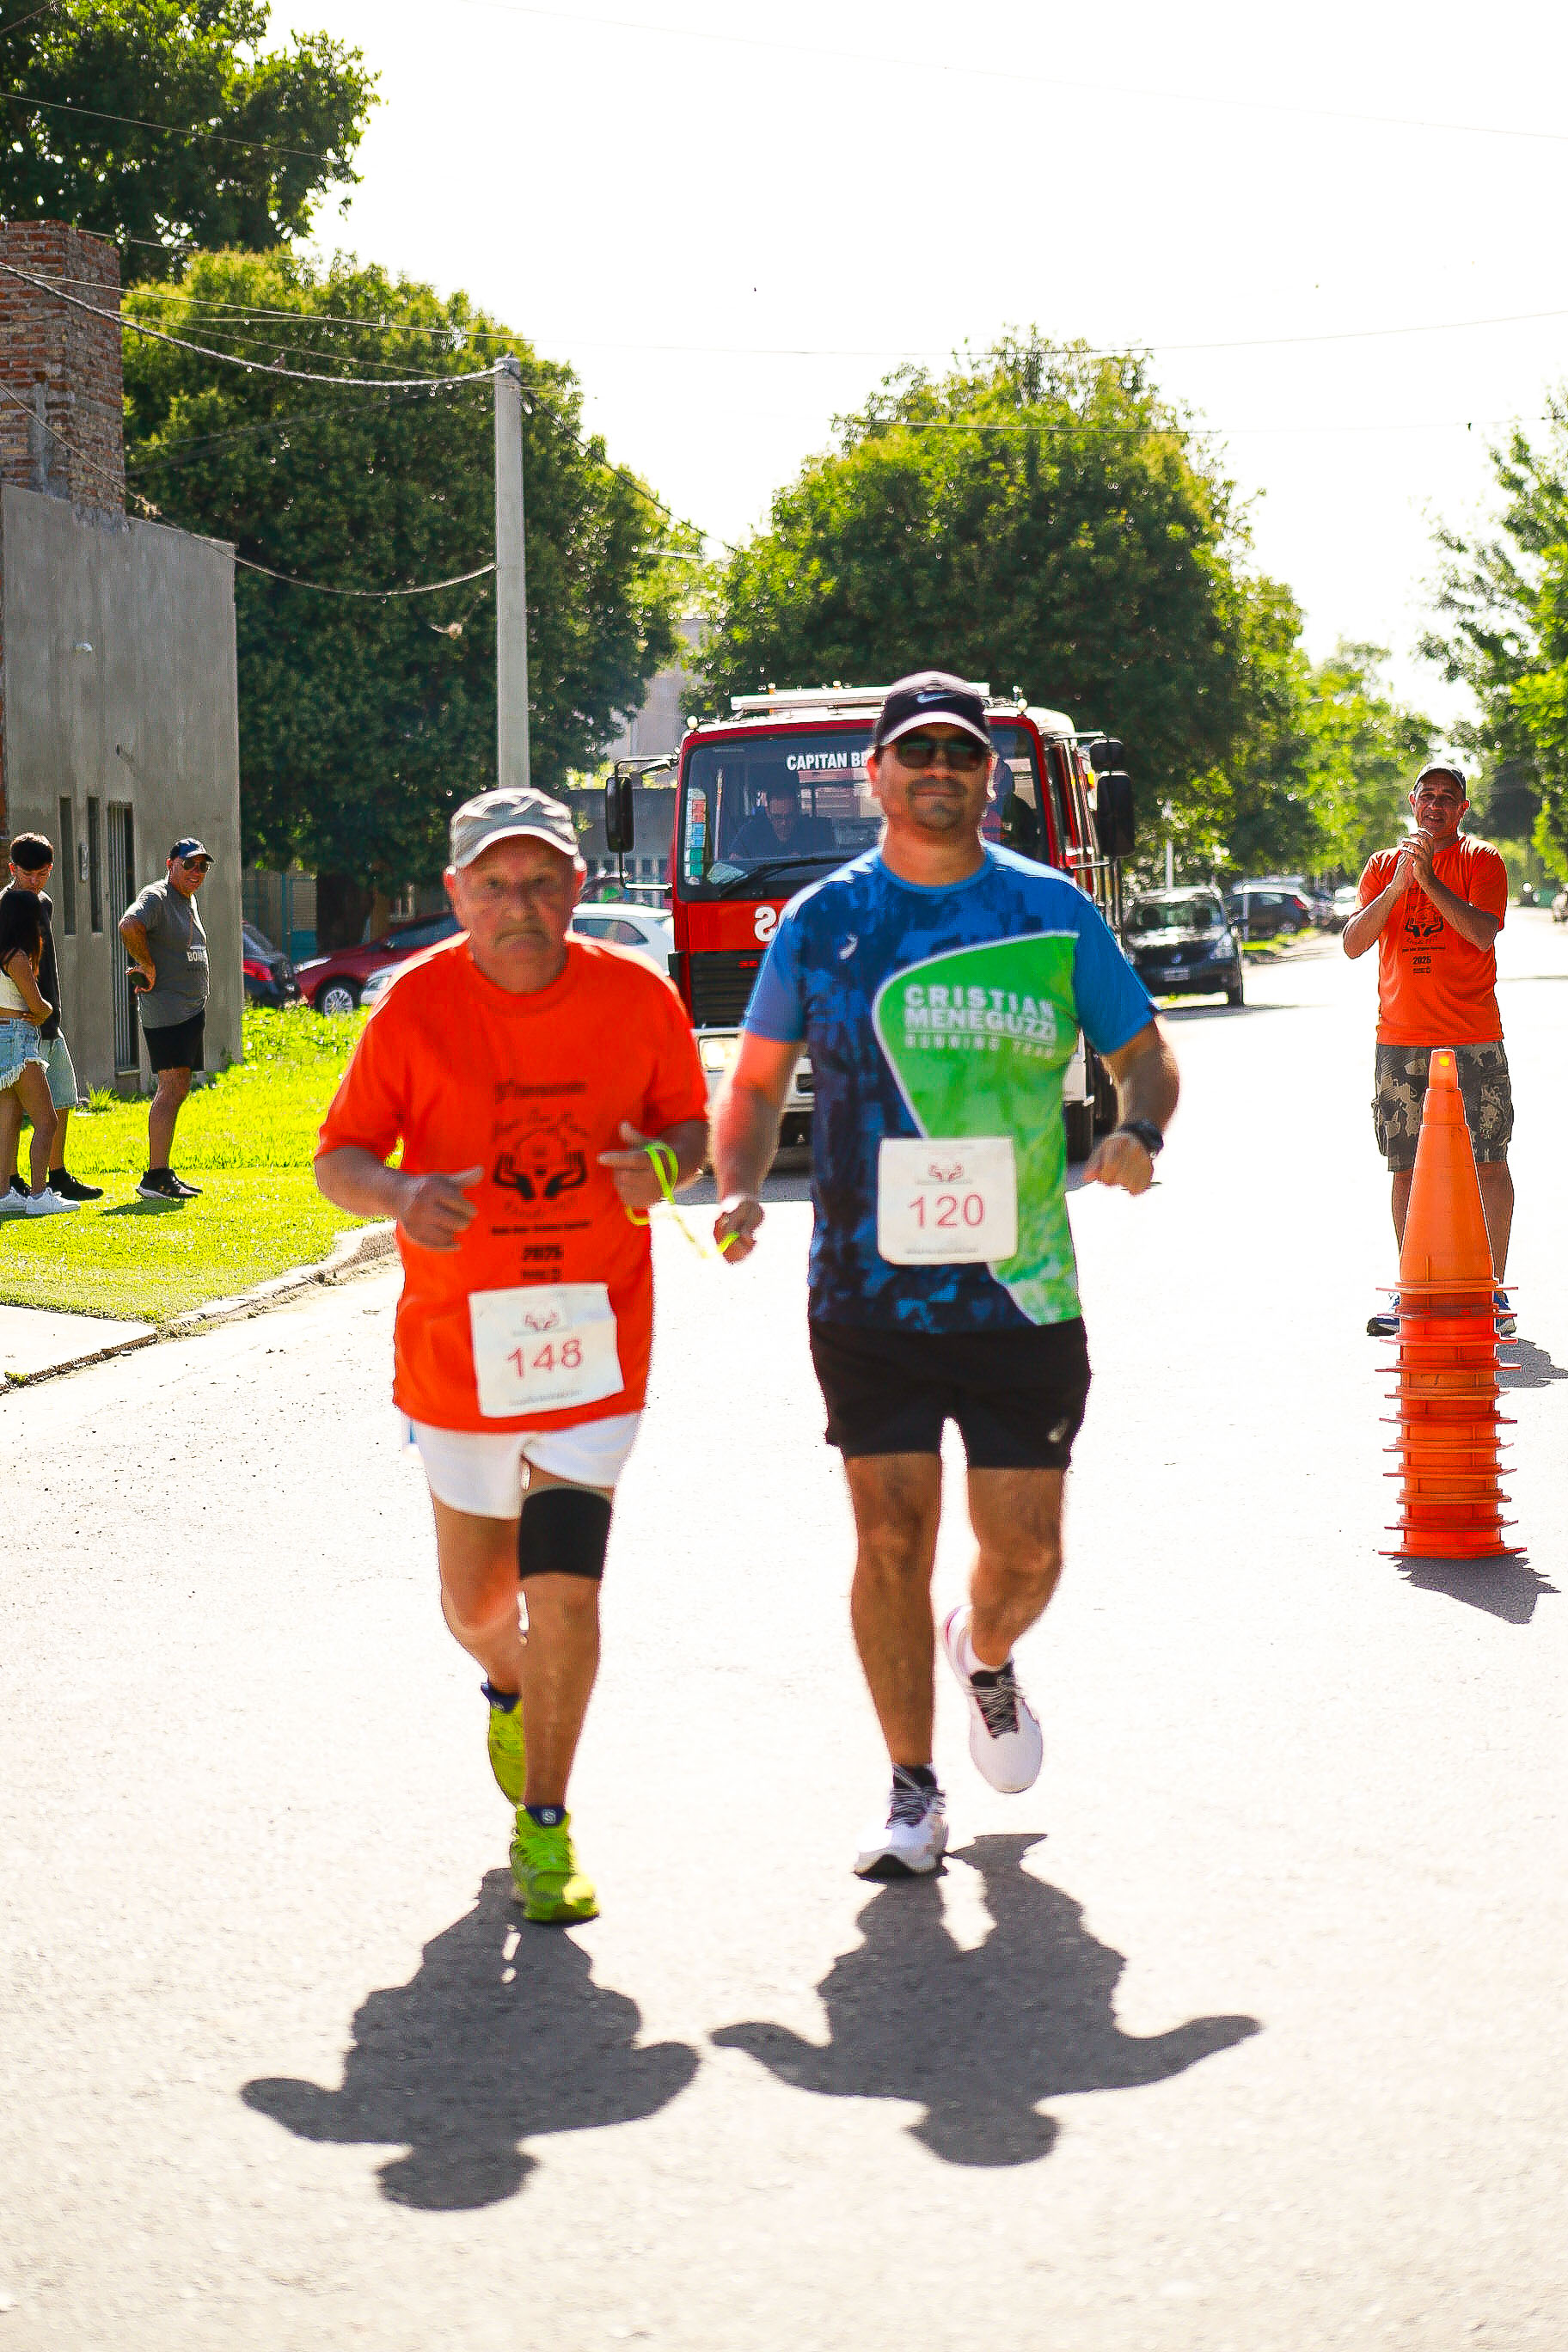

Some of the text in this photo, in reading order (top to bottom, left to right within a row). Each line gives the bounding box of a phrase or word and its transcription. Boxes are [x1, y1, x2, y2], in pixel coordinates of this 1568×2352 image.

[787, 752, 848, 771] CAPITAN
[905, 984, 1055, 1018] CRISTIAN
[909, 1192, 984, 1229] 120
[506, 1338, 583, 1378] 148
